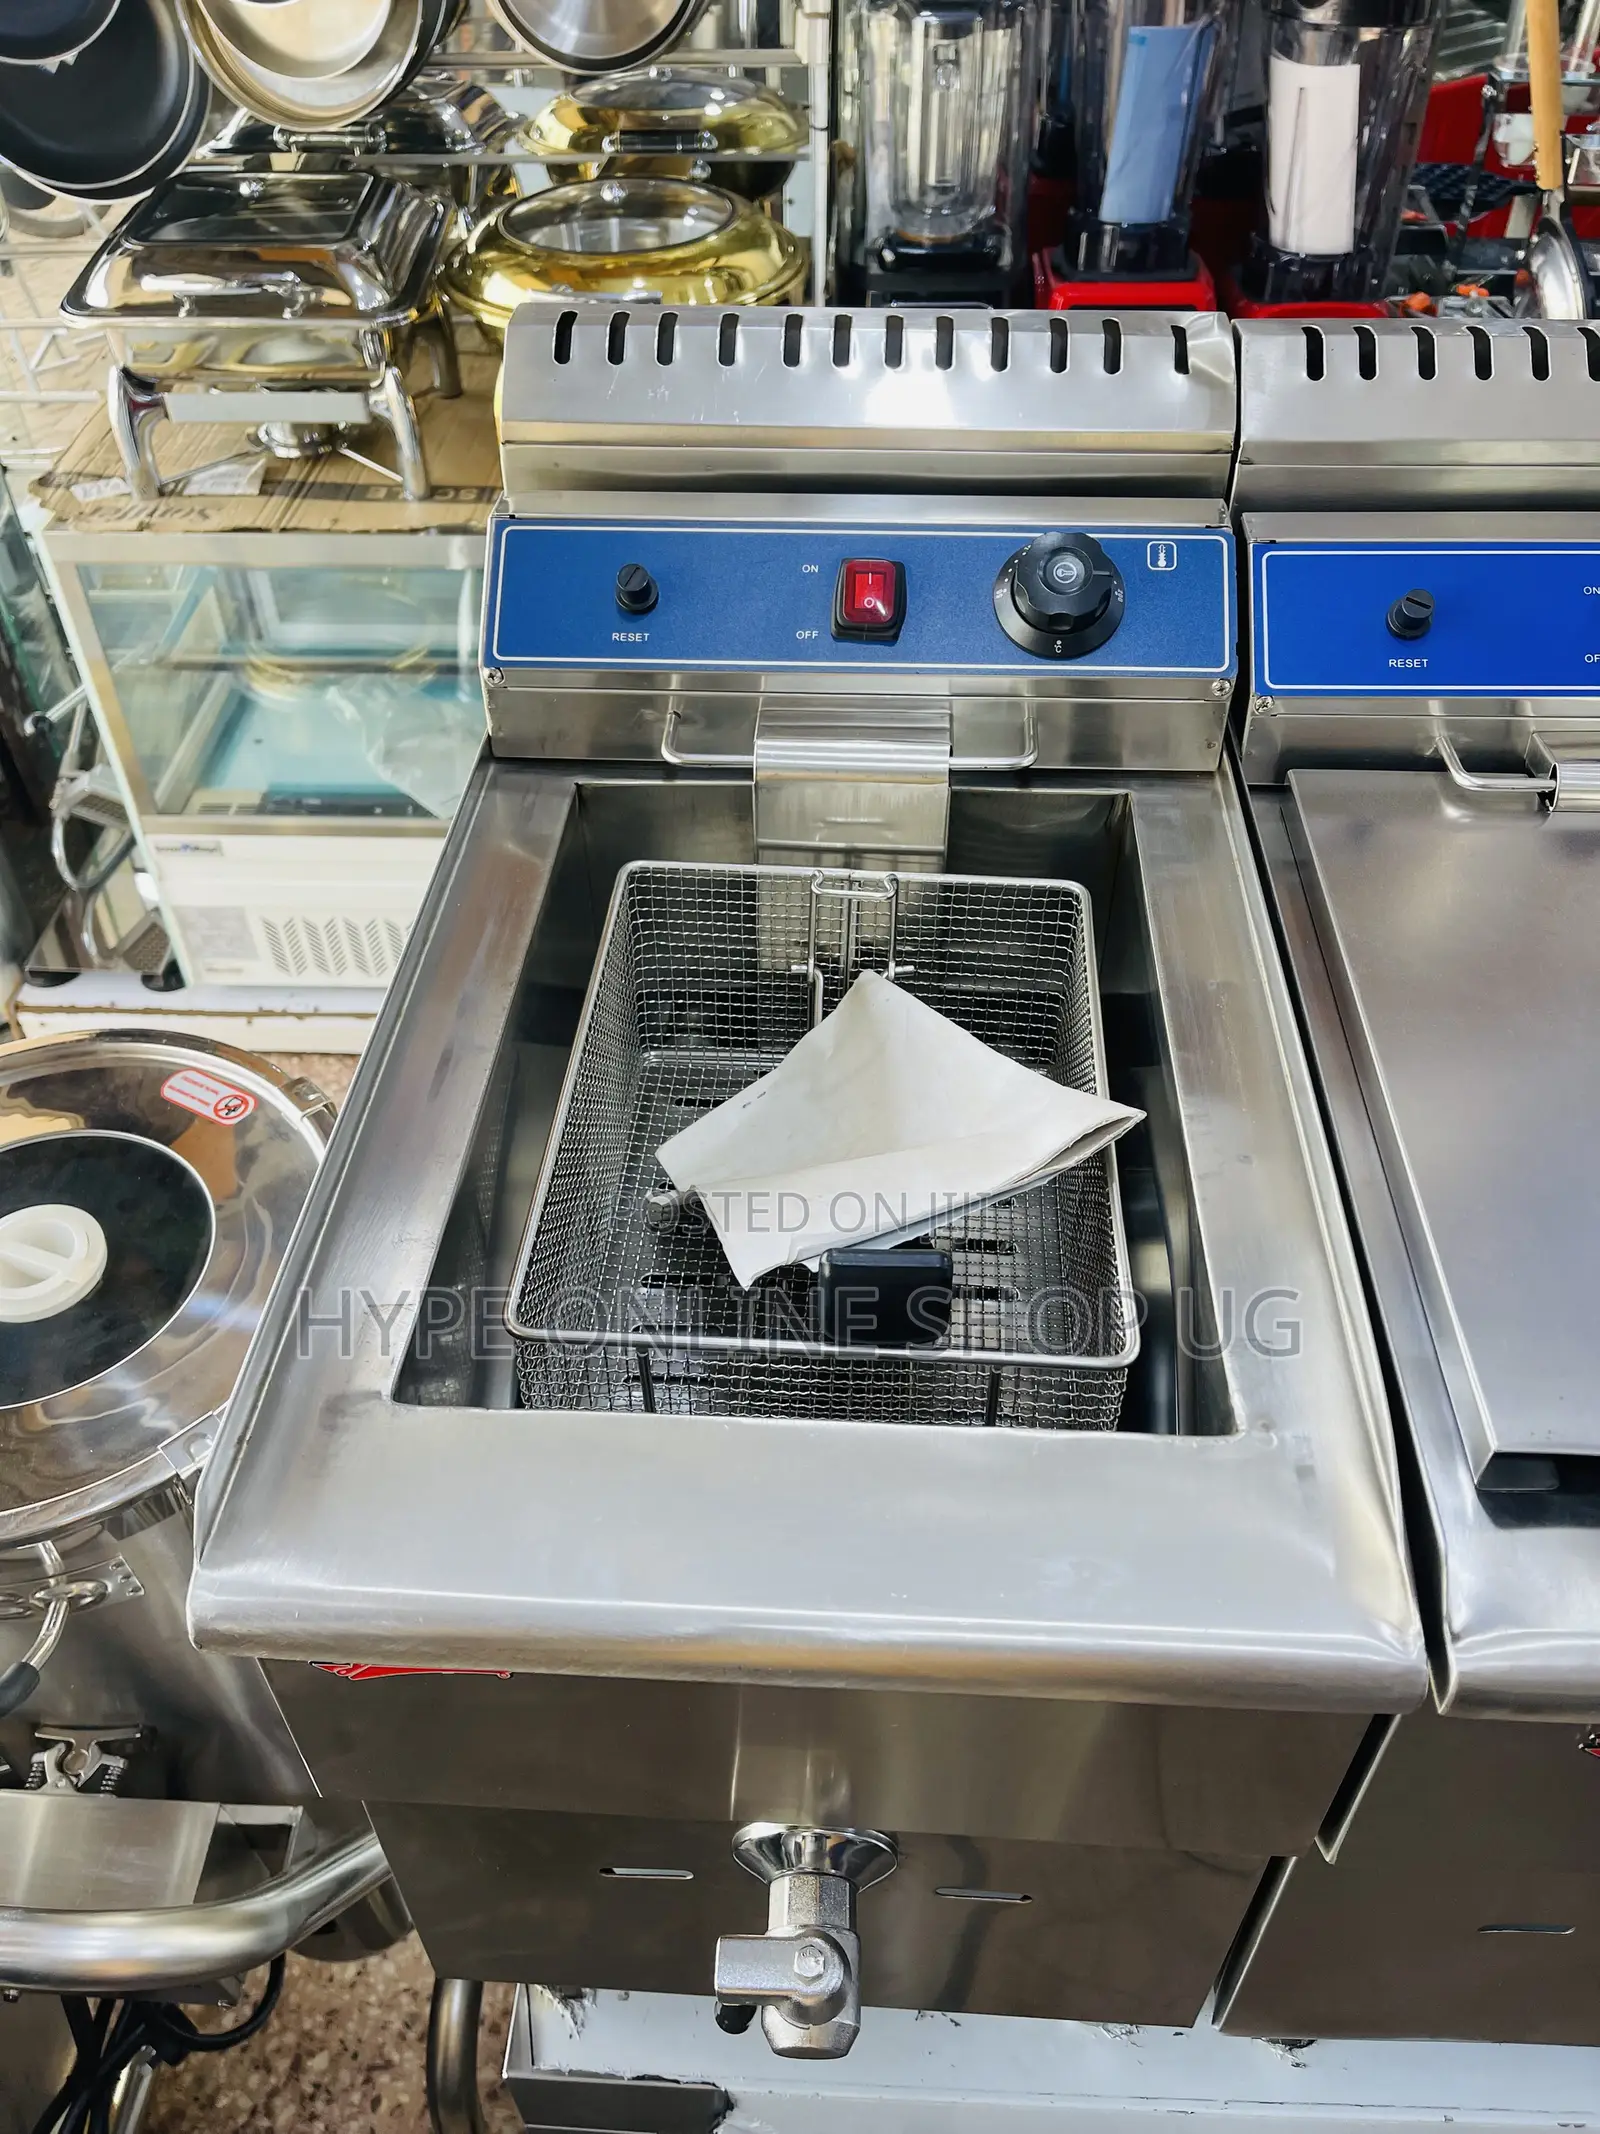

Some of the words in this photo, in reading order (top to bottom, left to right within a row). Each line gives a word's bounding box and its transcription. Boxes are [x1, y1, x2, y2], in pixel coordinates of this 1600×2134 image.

[802, 564, 819, 573] ON
[1583, 586, 1600, 595] ON
[611, 632, 650, 642] RESET
[796, 630, 819, 640] OFF
[1388, 658, 1429, 668] RESET
